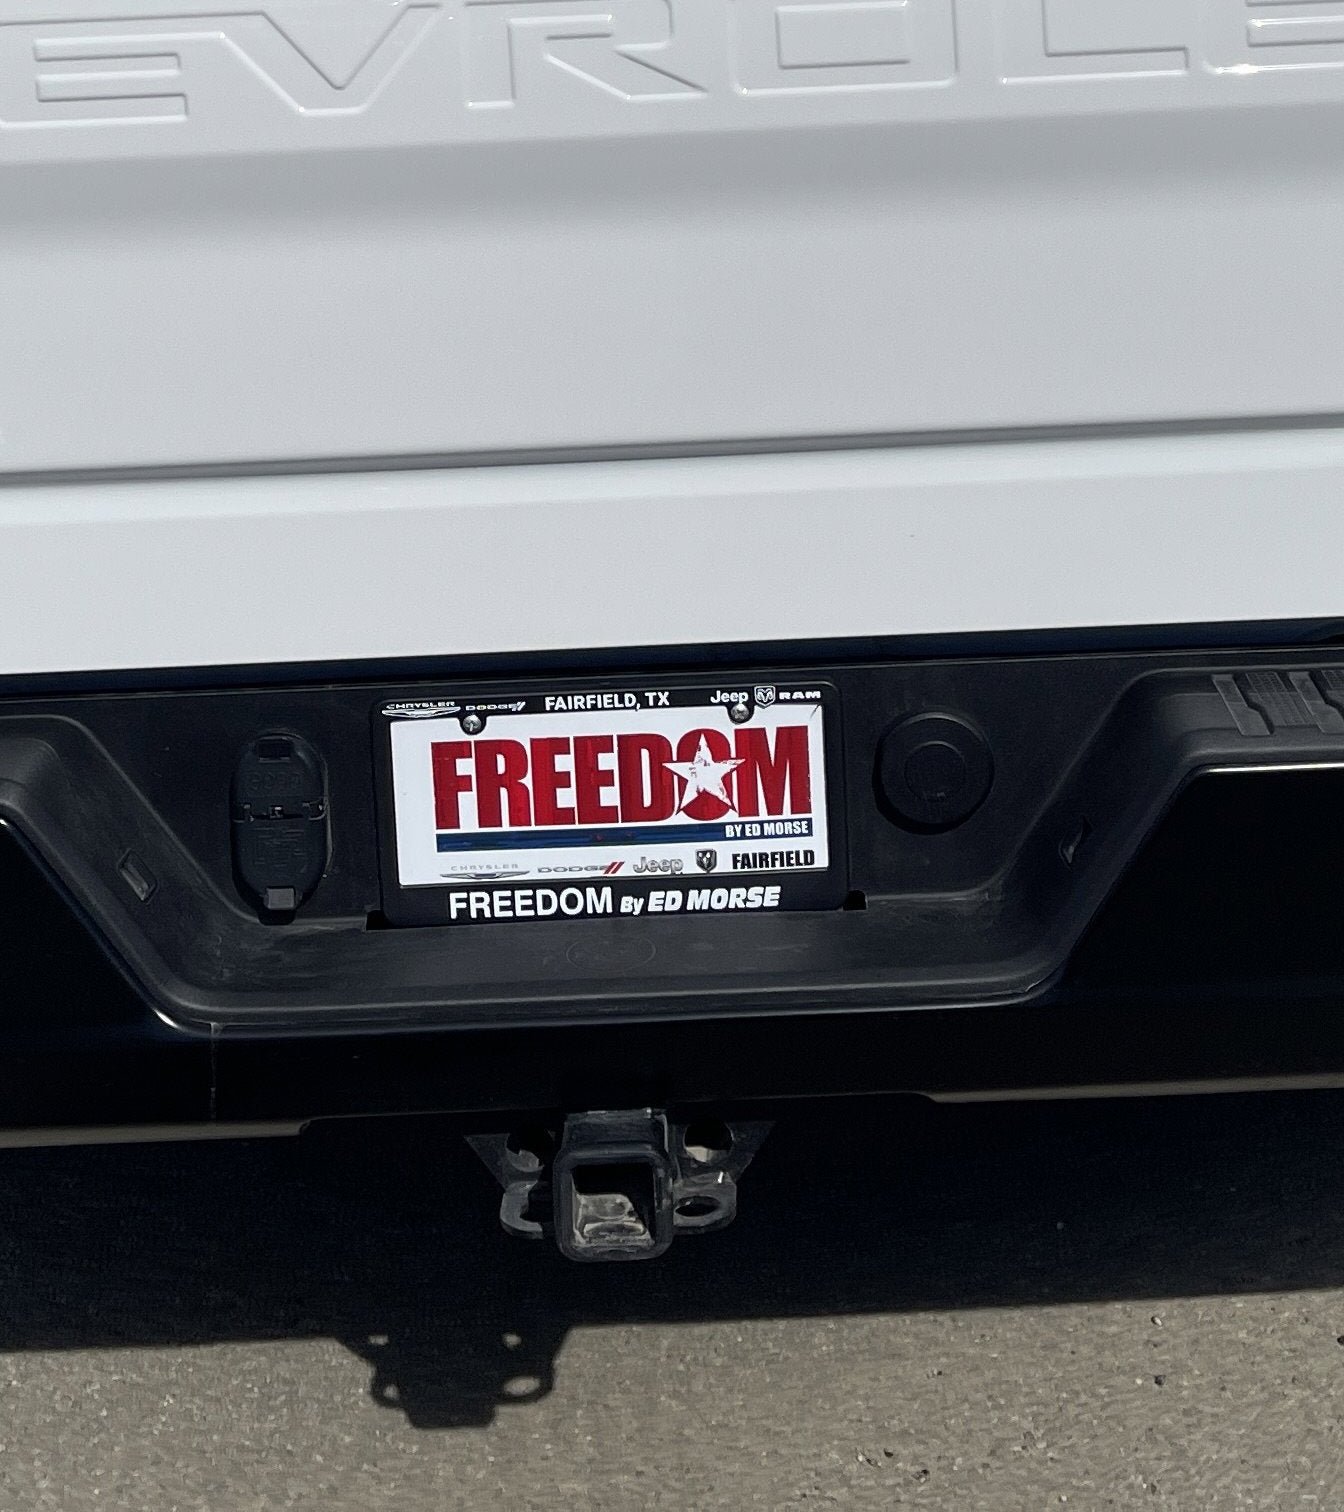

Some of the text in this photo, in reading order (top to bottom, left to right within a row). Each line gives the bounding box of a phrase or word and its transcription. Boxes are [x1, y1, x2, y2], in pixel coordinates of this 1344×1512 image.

[386, 701, 456, 710] CHRYSLER
[544, 691, 670, 711] FAIRFIELD, TX
[710, 690, 822, 705] Jeep RAM
[431, 725, 813, 830] FREEDOM
[725, 821, 809, 838] BY ED MORSE
[450, 863, 519, 871] CHRYSLER
[633, 857, 684, 874] Jeep
[732, 849, 815, 870] FAIRFIELD
[449, 885, 782, 920] FREEDOM By ED MORSE
